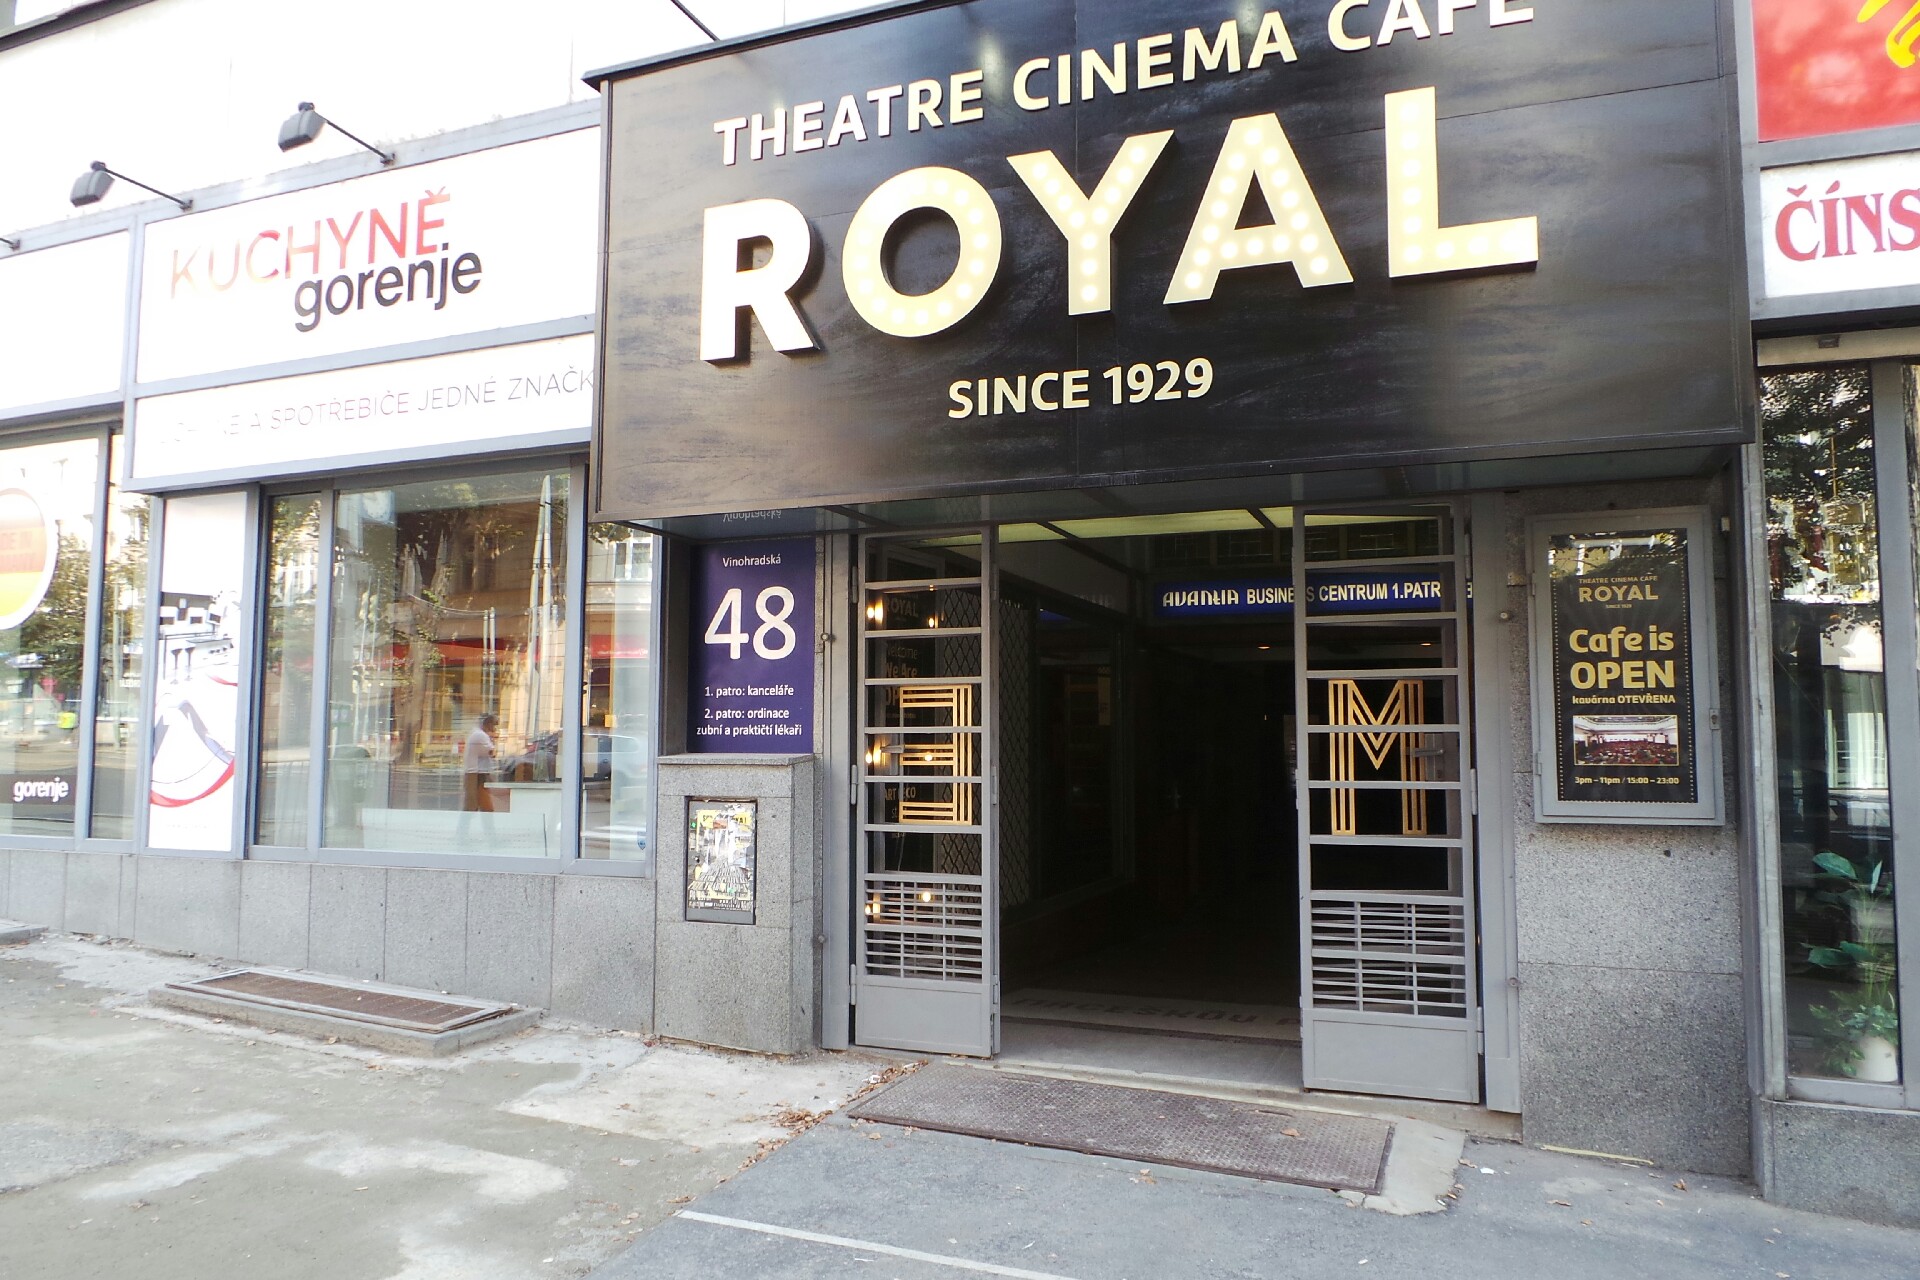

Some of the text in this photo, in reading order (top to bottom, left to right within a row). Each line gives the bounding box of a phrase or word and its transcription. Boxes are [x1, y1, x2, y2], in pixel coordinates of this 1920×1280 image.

[713, 69, 985, 165] THEATRE
[1012, 9, 1298, 111] CINEMA
[699, 86, 1539, 362] ROYAL
[1775, 180, 1920, 262] ČÍNS
[169, 186, 452, 301] KUCHYNĚ
[294, 242, 483, 333] gorenje
[416, 376, 498, 412] JEDNÉ
[948, 357, 1214, 419] SINCE 1929
[722, 554, 782, 568] Vinohradská
[1319, 582, 1388, 602] CENTRUM
[1578, 584, 1659, 603] ROYAL
[704, 586, 796, 660] 48
[1568, 625, 1675, 658] Cafe is
[1570, 660, 1675, 688] OPEN
[704, 684, 794, 700] 1. patro: kanceláře
[1572, 693, 1676, 705] kavárna OTEVŘENA
[704, 707, 790, 722] 2. patro: ordinace
[696, 723, 802, 738] zubní a praktičtí lékaři
[13, 776, 69, 803] gorenje
[1574, 776, 1594, 786] 3pm
[1600, 776, 1622, 786] 11pm
